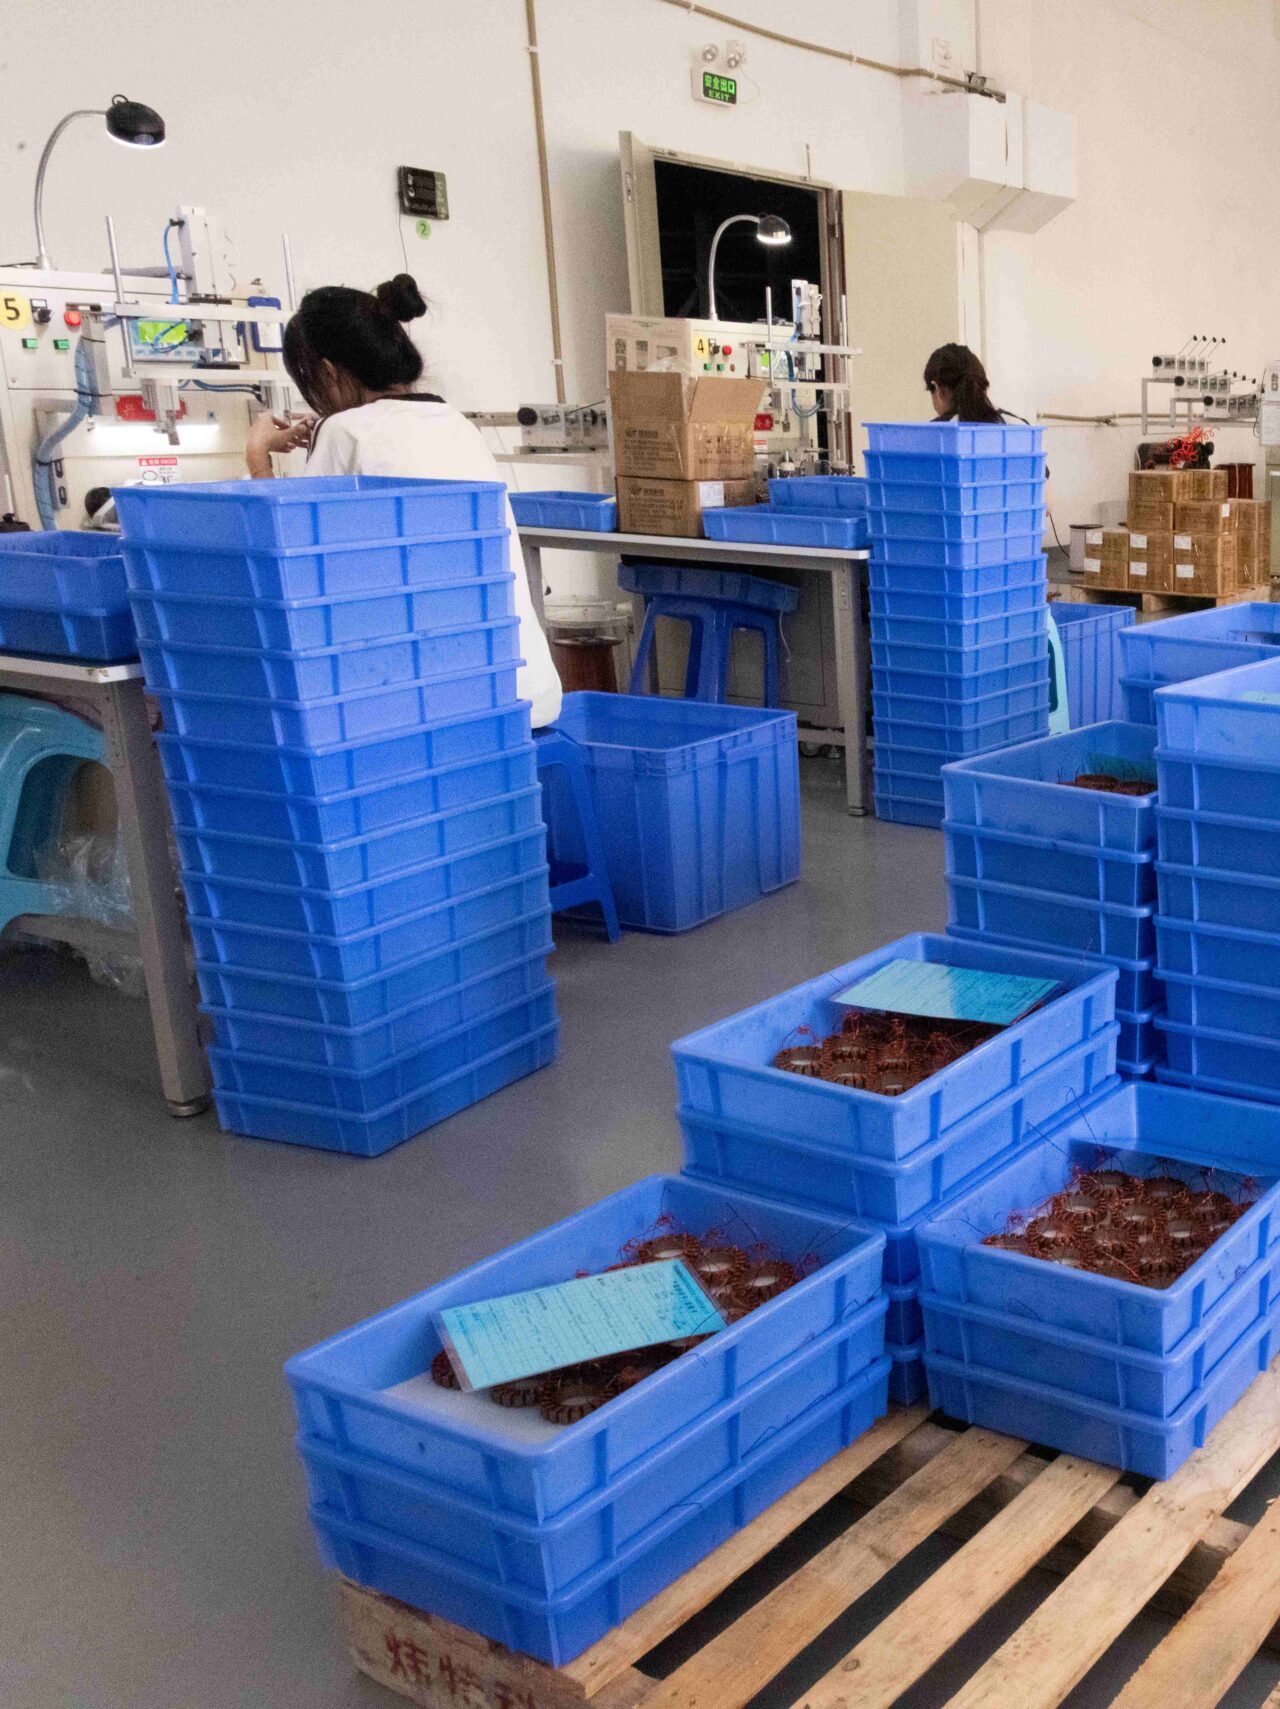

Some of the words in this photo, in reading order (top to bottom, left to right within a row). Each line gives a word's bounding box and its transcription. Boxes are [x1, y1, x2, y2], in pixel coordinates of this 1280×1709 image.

[708, 90, 730, 101] EXIT
[3, 297, 20, 321] 5
[697, 338, 704, 354] 4
